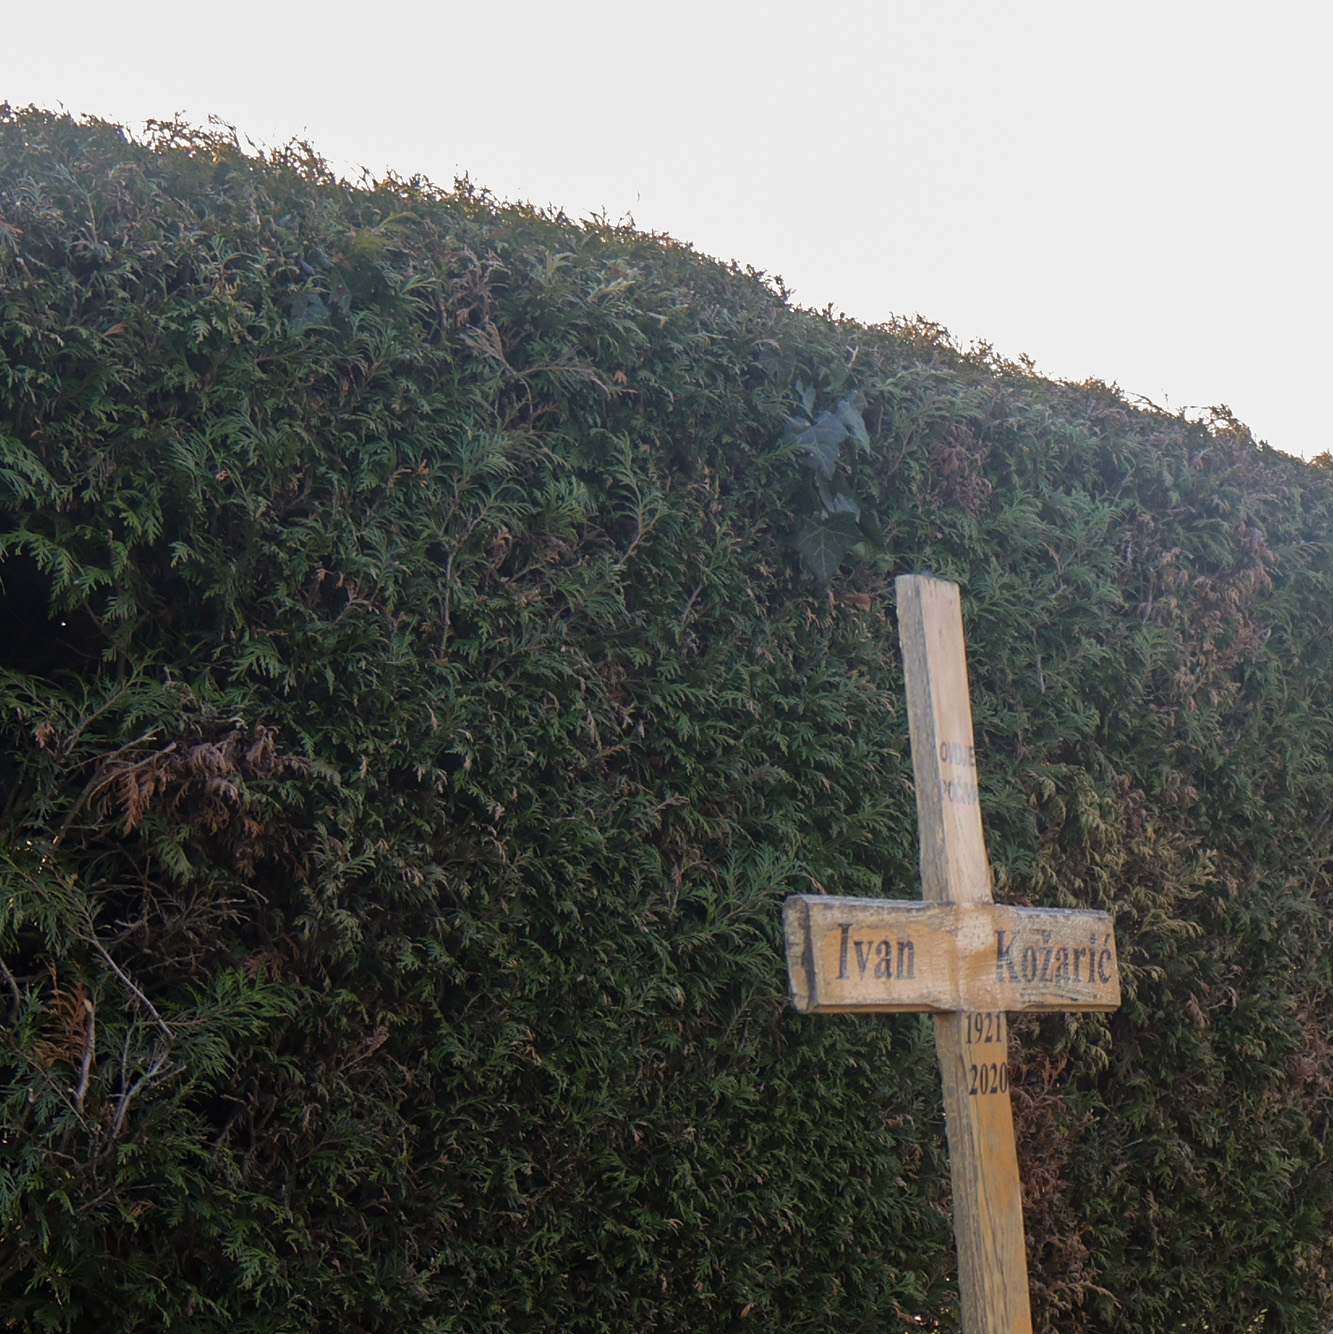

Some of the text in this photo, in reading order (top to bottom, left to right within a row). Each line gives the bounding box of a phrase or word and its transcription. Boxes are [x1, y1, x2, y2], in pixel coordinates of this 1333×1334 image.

[835, 923, 1112, 984] Ivan Kožarić
[965, 1011, 1002, 1044] 1921
[968, 1063, 1009, 1096] 2020
